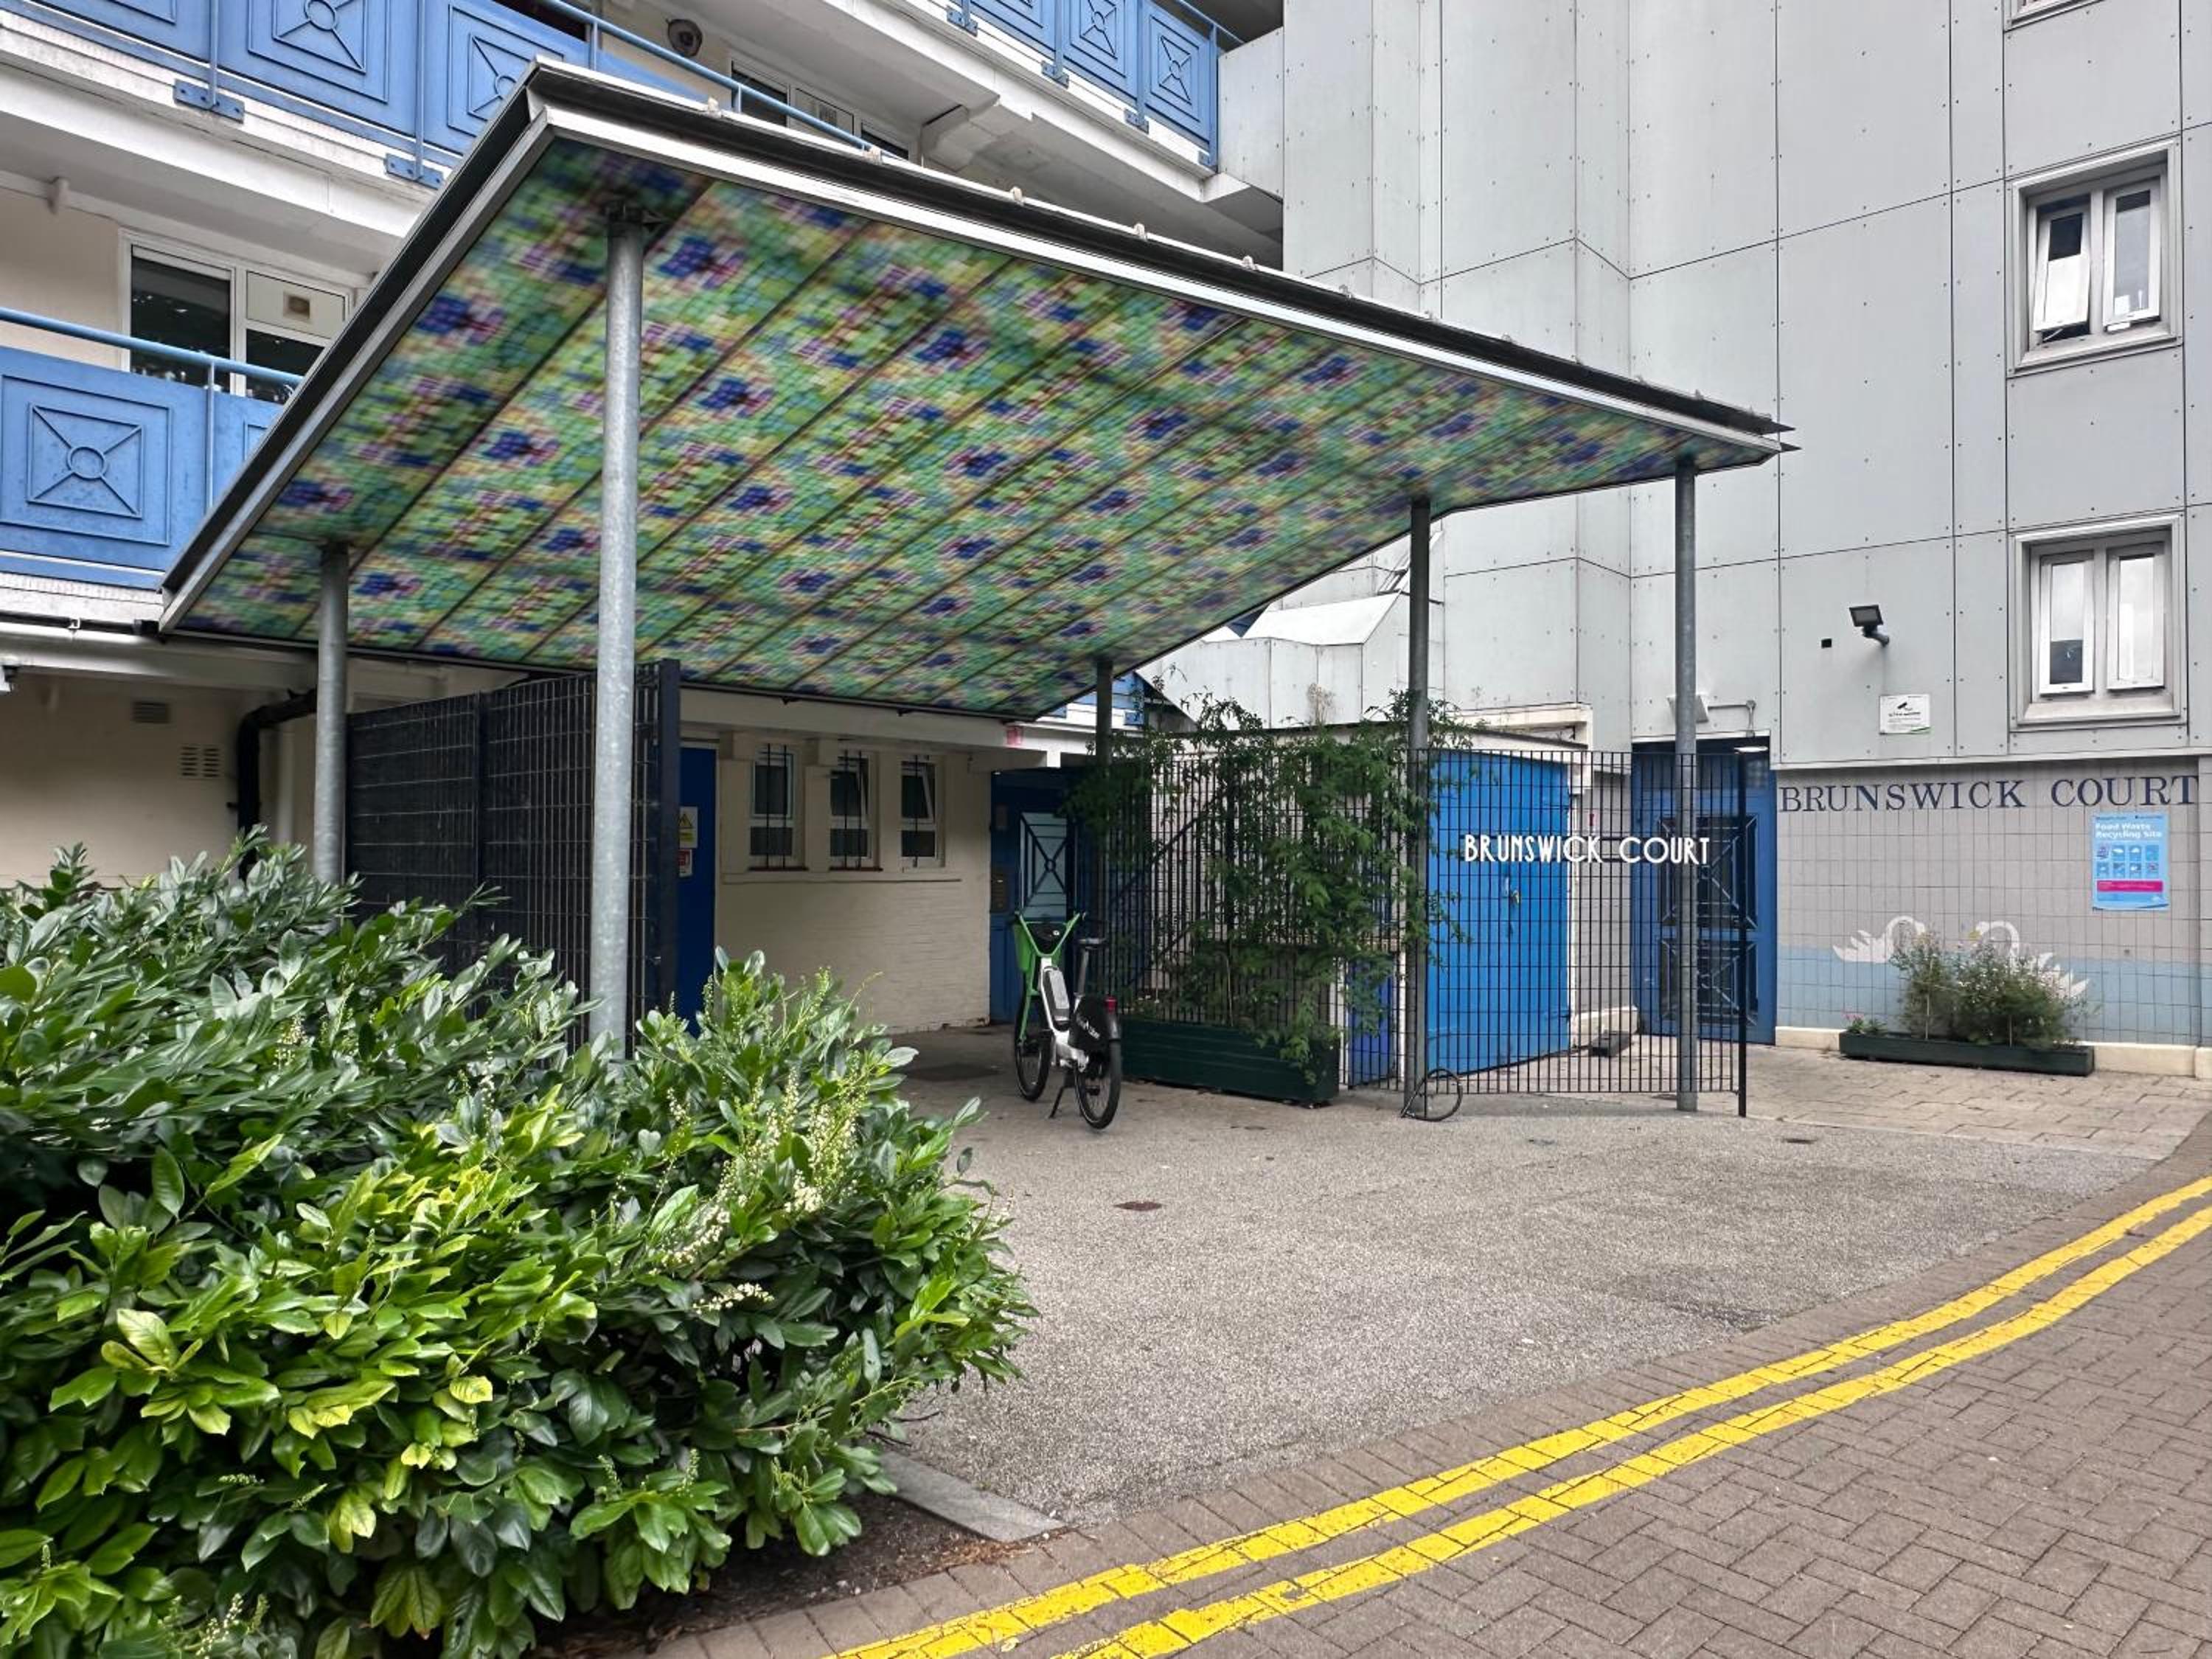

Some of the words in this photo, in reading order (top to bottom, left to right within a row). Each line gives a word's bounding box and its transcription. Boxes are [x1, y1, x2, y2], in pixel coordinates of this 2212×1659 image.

[1779, 780, 2026, 812] BRUNSWICK
[2051, 776, 2199, 807] COURT
[2096, 830, 2140, 838] Recycling
[1464, 835, 1603, 863] BRUNSWICK
[1619, 836, 1710, 865] COURT
